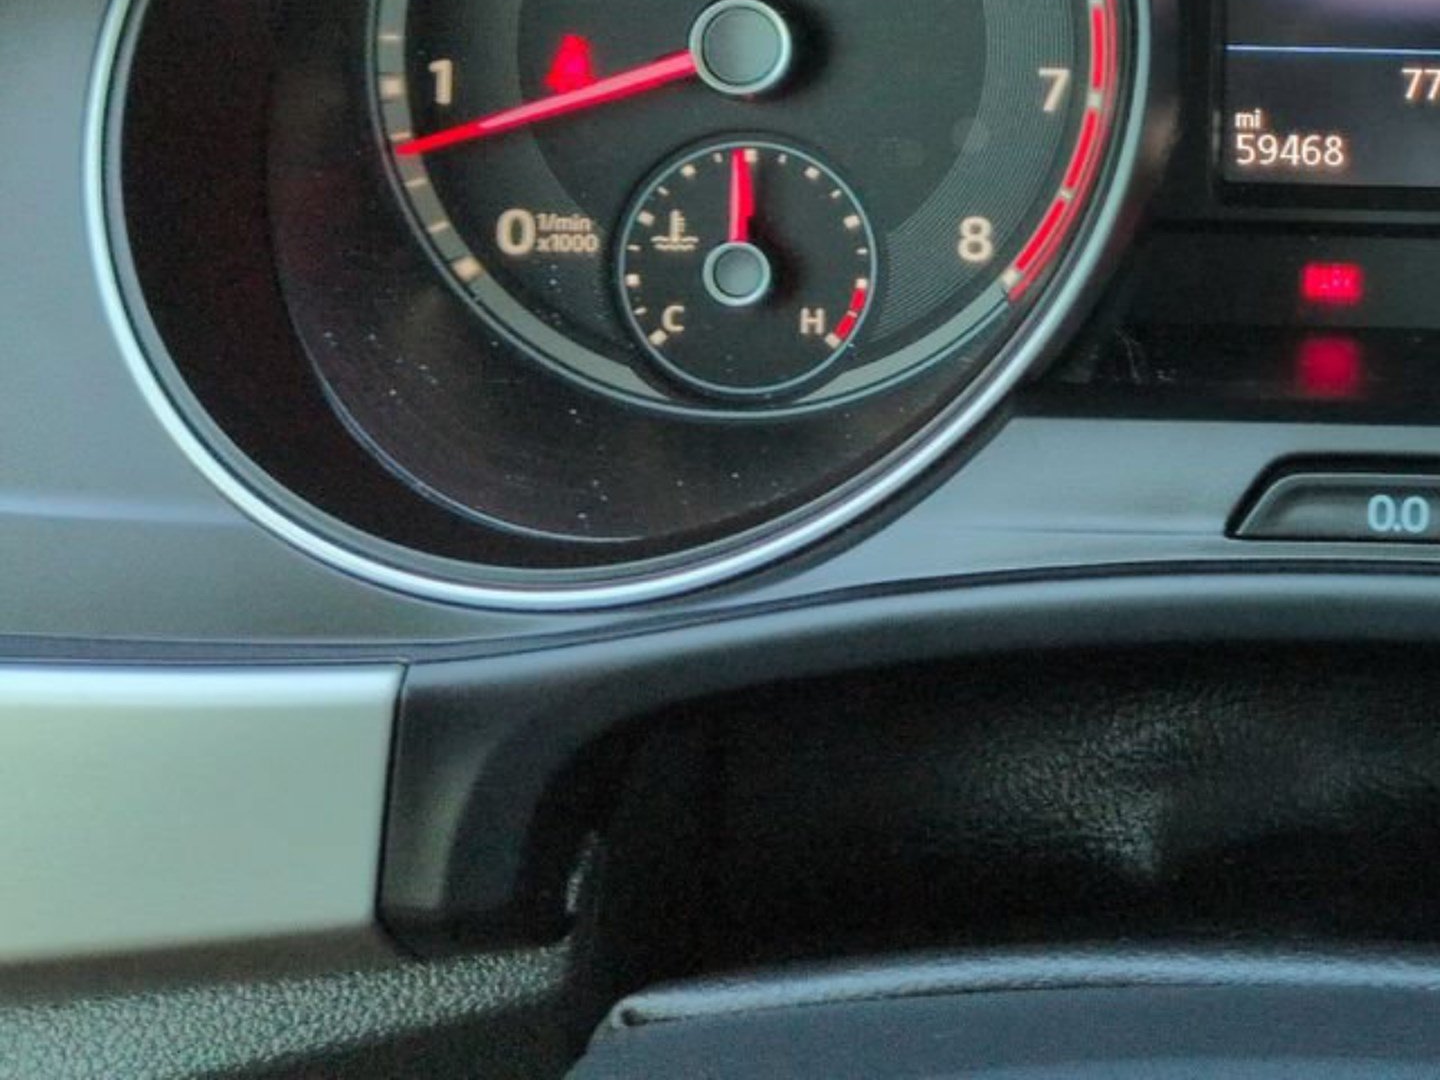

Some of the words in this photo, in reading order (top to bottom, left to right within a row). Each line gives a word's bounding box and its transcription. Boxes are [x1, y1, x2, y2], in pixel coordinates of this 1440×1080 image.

[428, 59, 455, 106] 1
[1037, 68, 1070, 114] 7
[1235, 109, 1261, 129] mi
[1234, 134, 1344, 167] 59468
[496, 208, 536, 256] 0
[537, 233, 599, 253] x1000
[957, 217, 994, 262] 8
[661, 305, 685, 333] C
[800, 307, 825, 334] H
[1368, 494, 1430, 534] 0.0
